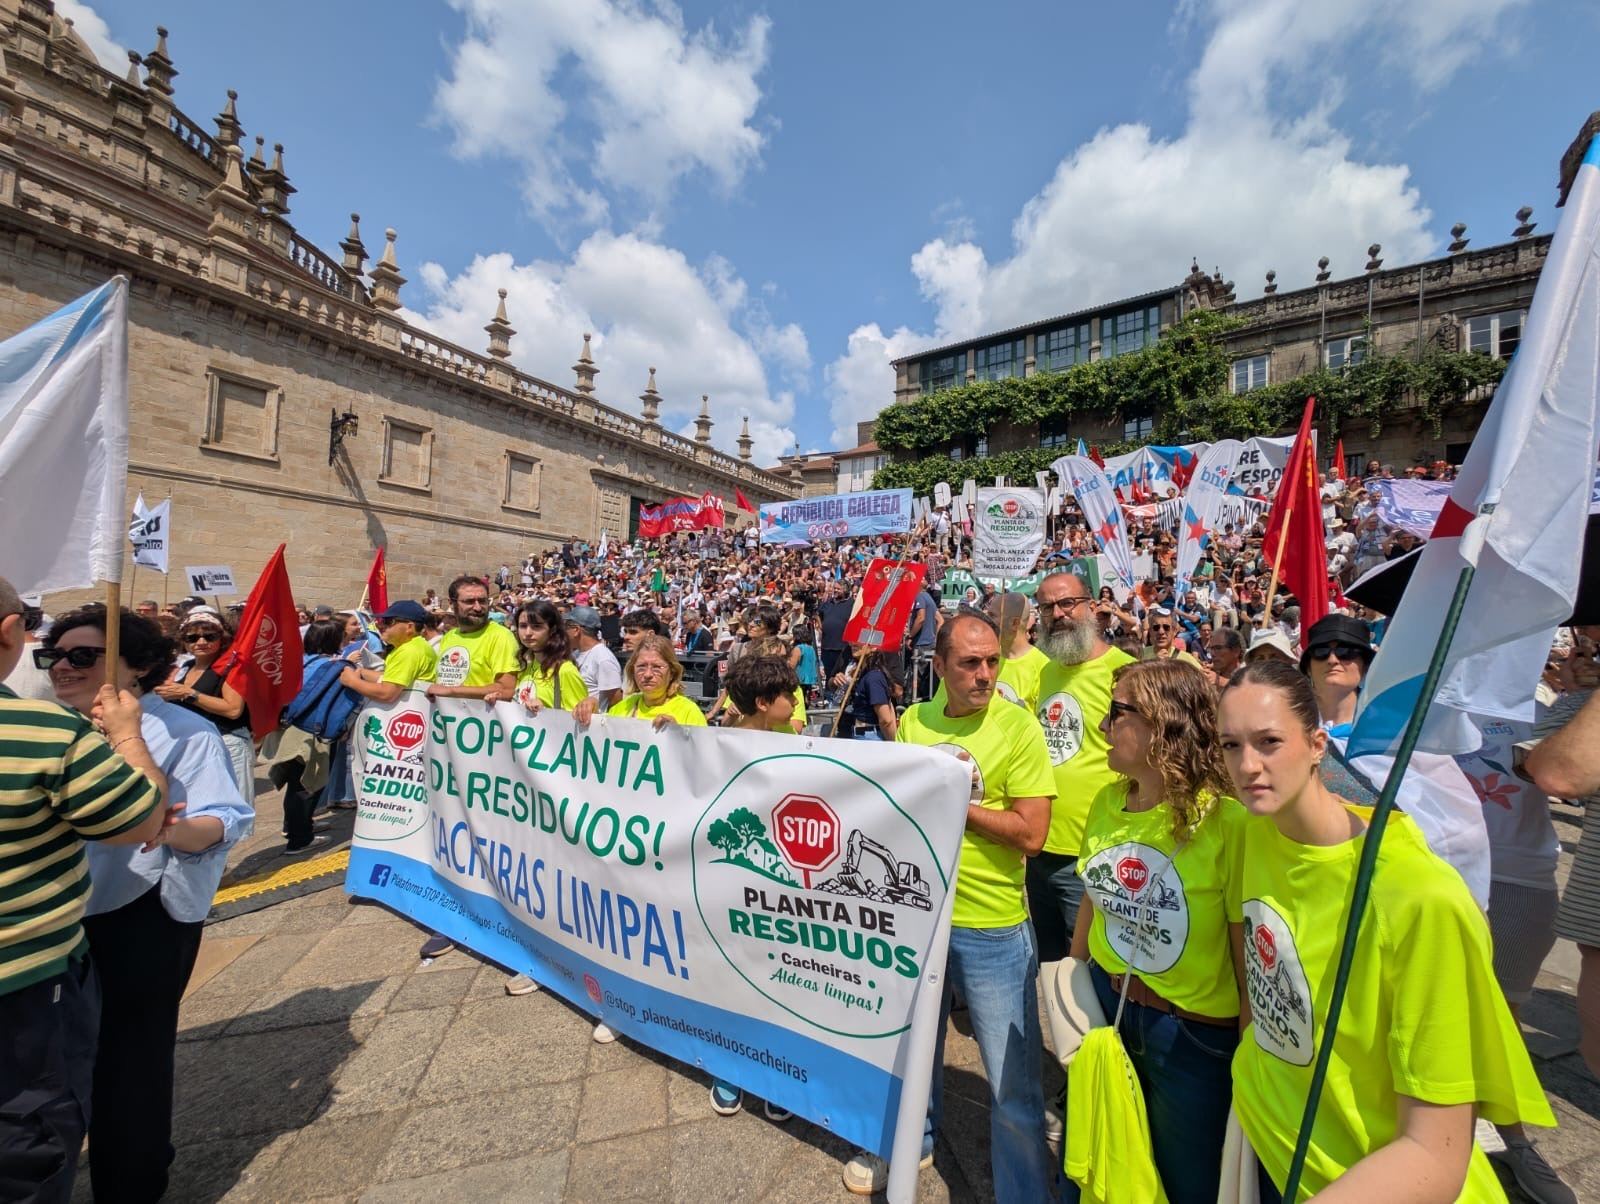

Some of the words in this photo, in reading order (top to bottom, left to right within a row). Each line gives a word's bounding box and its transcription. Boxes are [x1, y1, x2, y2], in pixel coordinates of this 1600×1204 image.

[781, 497, 844, 524] REPÚBLICA
[847, 494, 901, 518] GALEGA
[392, 721, 423, 740] STOP
[432, 710, 504, 757] STOP
[510, 725, 664, 796] PLANTA
[363, 761, 414, 781] LANTA
[361, 777, 428, 804] SIDUOS
[467, 771, 666, 871] RESIDUOS!
[782, 815, 832, 849] STOP
[391, 873, 423, 896] Plataforma
[422, 886, 440, 903] STOP
[1121, 867, 1146, 881] STOP
[557, 869, 690, 980] LIMPA!
[743, 886, 852, 926] PLANTA
[859, 906, 896, 937] DE
[1145, 909, 1160, 924] DE
[728, 908, 920, 979] RESIDUOS
[1256, 932, 1274, 958] STOP
[781, 952, 862, 986] Cacheiras
[769, 967, 819, 993] Aldeas
[824, 982, 884, 1014] limpas!
[1275, 998, 1291, 1022] DE
[604, 990, 809, 1084] @stop_plantaderesiduoscacheiras
